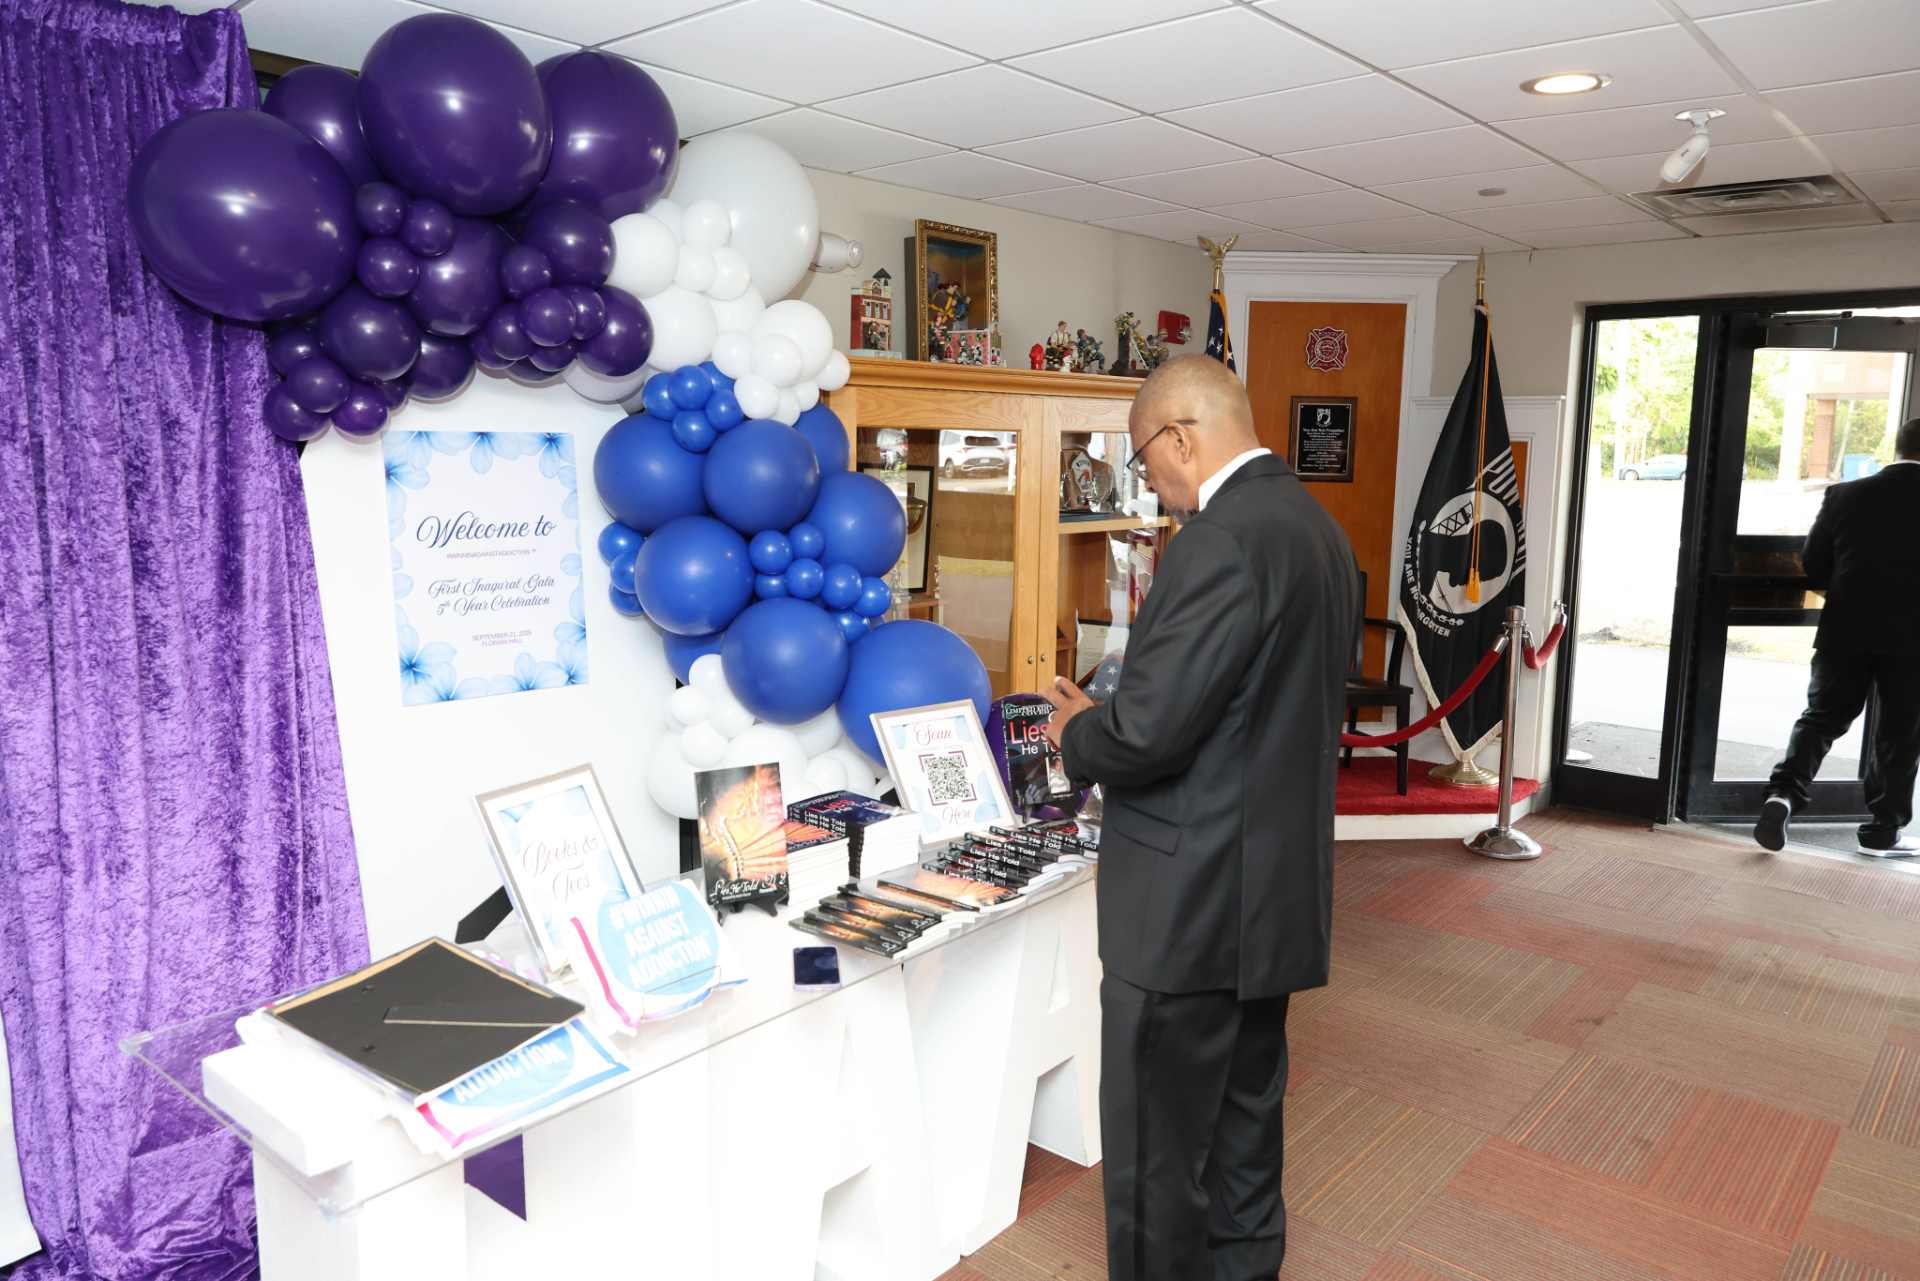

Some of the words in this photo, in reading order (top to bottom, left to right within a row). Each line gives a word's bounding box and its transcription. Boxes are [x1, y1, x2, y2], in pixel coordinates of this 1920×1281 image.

[416, 510, 530, 549] Welcome
[534, 514, 557, 537] to
[1404, 563, 1415, 584] ARE
[428, 578, 462, 599] First
[523, 574, 555, 593] Gala
[454, 597, 489, 616] Year
[491, 595, 551, 612] Celebration
[913, 722, 952, 746] Scan
[1009, 720, 1049, 744] Lies
[1022, 743, 1038, 755] He
[942, 806, 972, 825] Here
[985, 839, 1001, 848] Lies
[1004, 844, 1016, 852] He
[1018, 847, 1036, 857] Told
[1010, 832, 1027, 841] Lies
[1044, 840, 1061, 850] Told
[1046, 831, 1062, 840] Lies
[1080, 840, 1096, 850] Told
[970, 848, 986, 857] Lies
[988, 853, 1000, 861] He
[1002, 856, 1020, 867] Told
[959, 859, 973, 868] Lies
[976, 864, 987, 872] He
[989, 868, 1007, 878] Told
[624, 911, 690, 961] AGAINST
[628, 935, 714, 989] ADDICTION
[453, 1040, 568, 1104] ADDICTION
